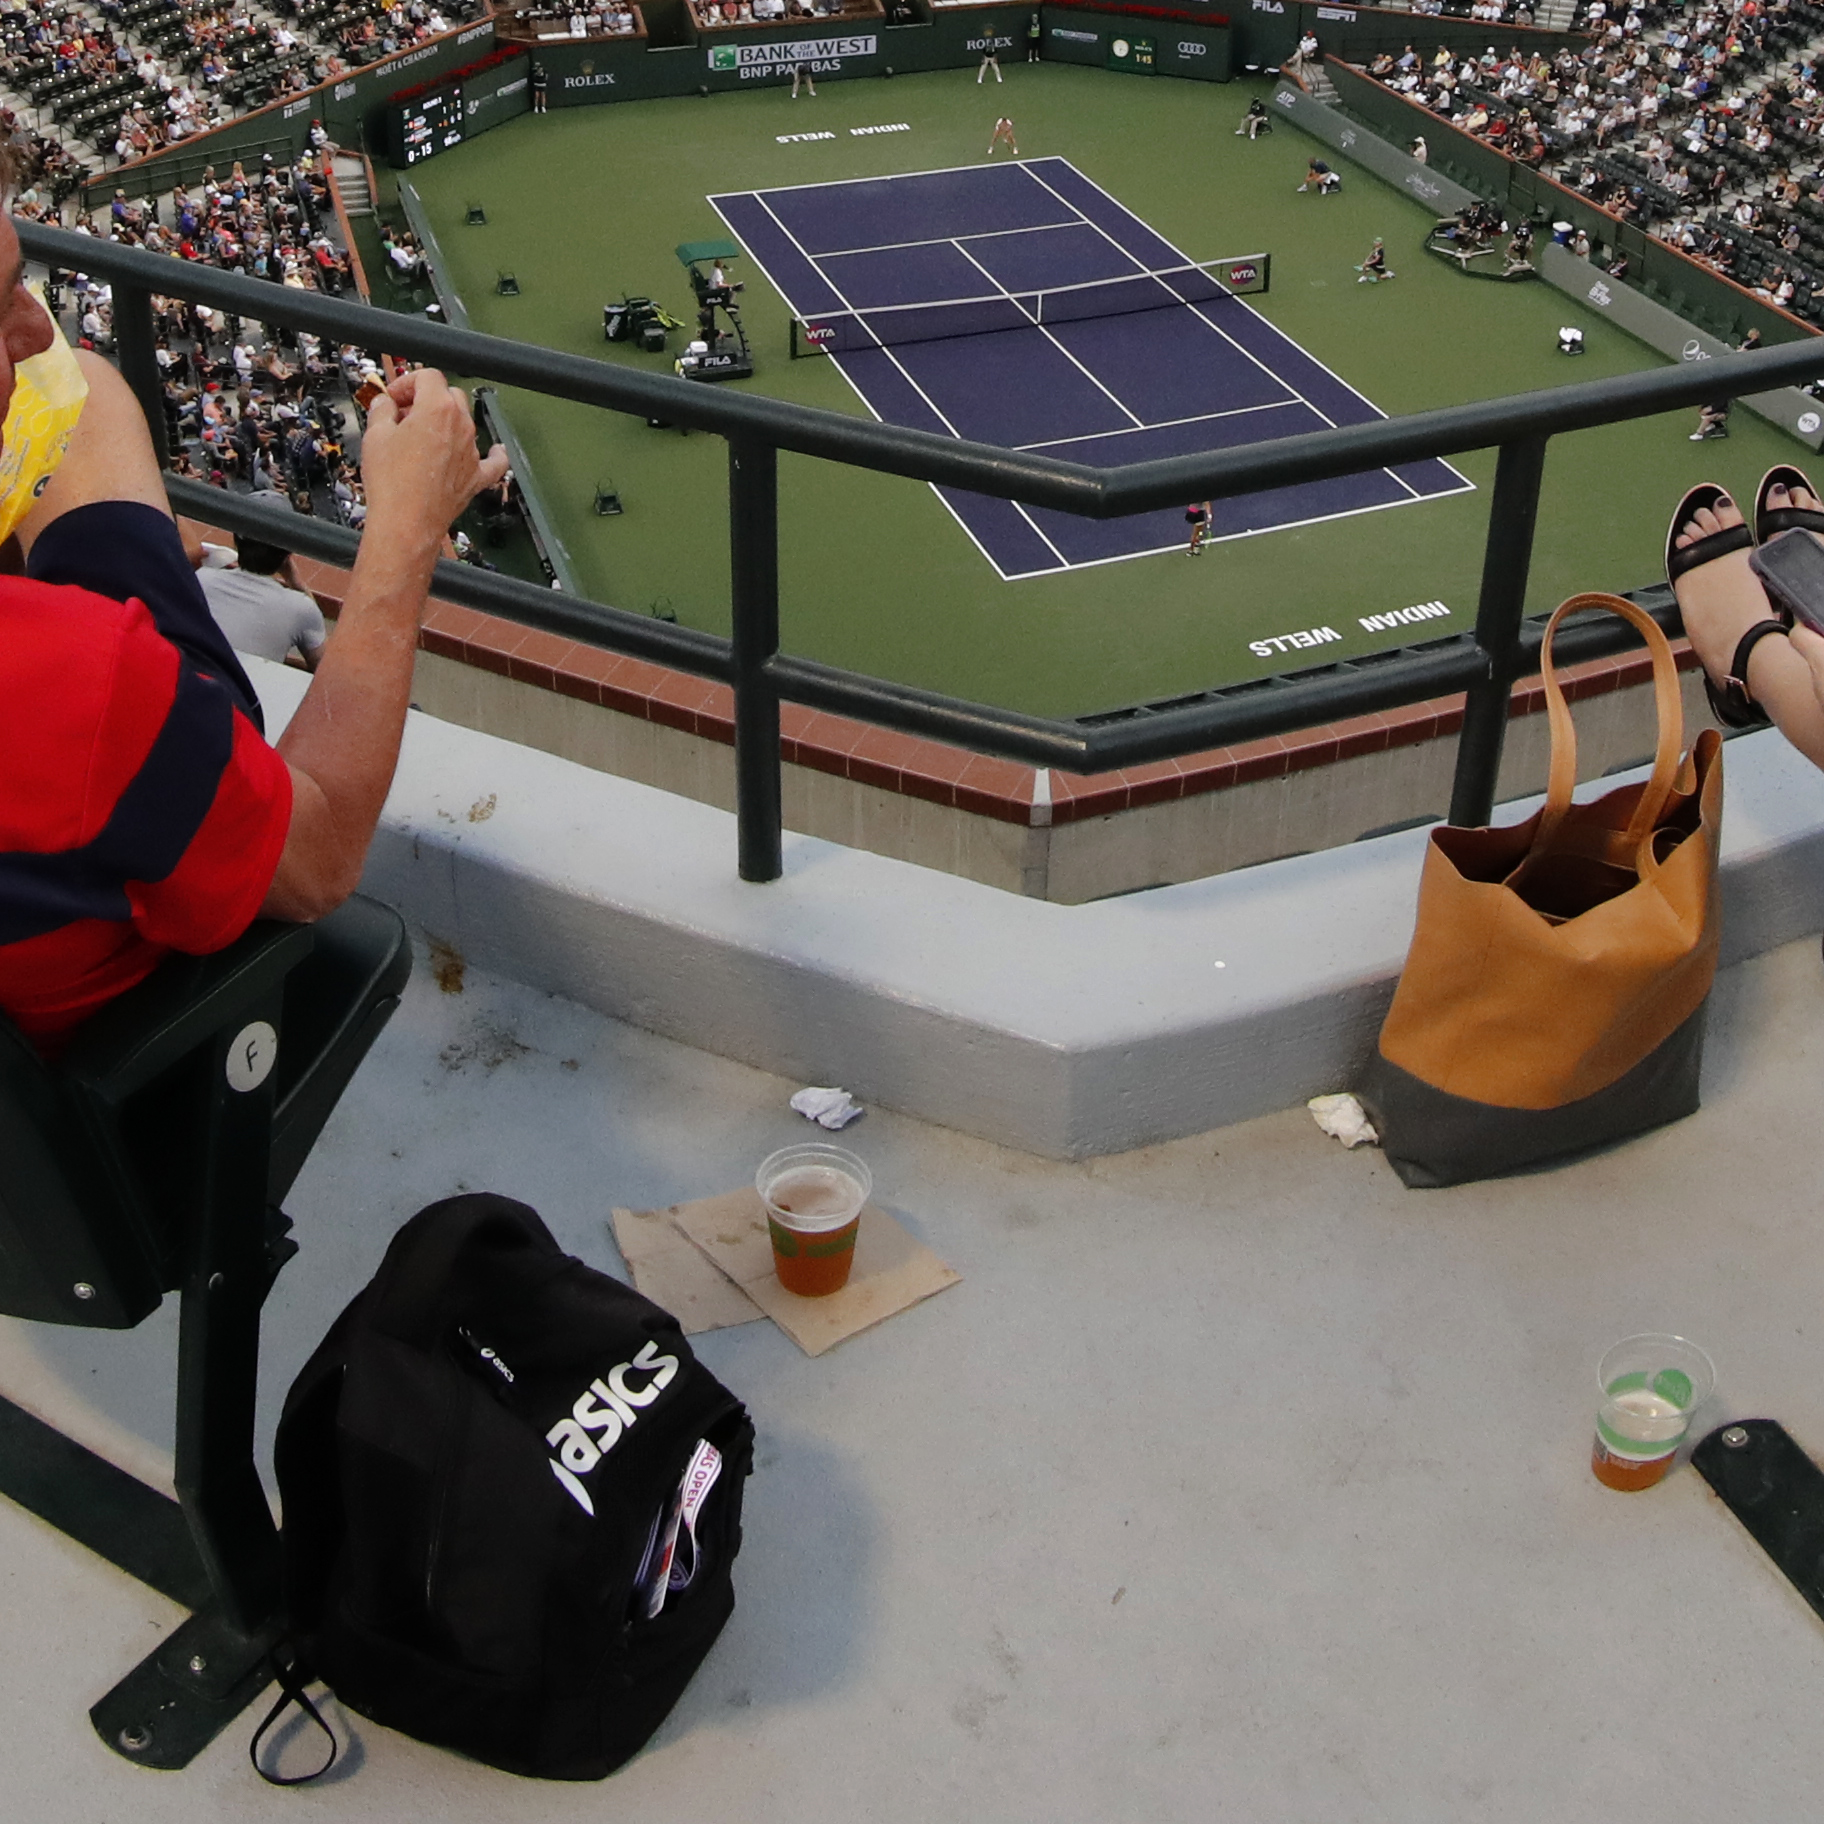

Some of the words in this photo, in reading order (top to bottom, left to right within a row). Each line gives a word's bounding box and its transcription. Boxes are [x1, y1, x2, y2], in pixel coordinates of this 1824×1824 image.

[1317, 6, 1357, 23] ESPN
[402, 45, 439, 66] CHANDON
[740, 45, 795, 63] BANK
[796, 50, 815, 58] THE
[815, 37, 873, 56] WEST
[739, 65, 772, 80] BNP
[564, 73, 615, 89] ROLEX
[1277, 90, 1296, 104] ATP
[775, 131, 836, 144] WELLS
[849, 123, 911, 136] INDIAN
[1231, 269, 1256, 280] WTA
[706, 296, 722, 305] FILA
[806, 328, 836, 340] WTA
[704, 355, 732, 367] FILA
[1801, 416, 1816, 428] WTA
[1358, 600, 1451, 633] INDIAN
[1248, 626, 1343, 657] WELLS
[246, 1039, 258, 1072] F
[492, 1357, 515, 1383] asics
[545, 1339, 679, 1473] asics
[686, 1470, 707, 1508] OPEN
